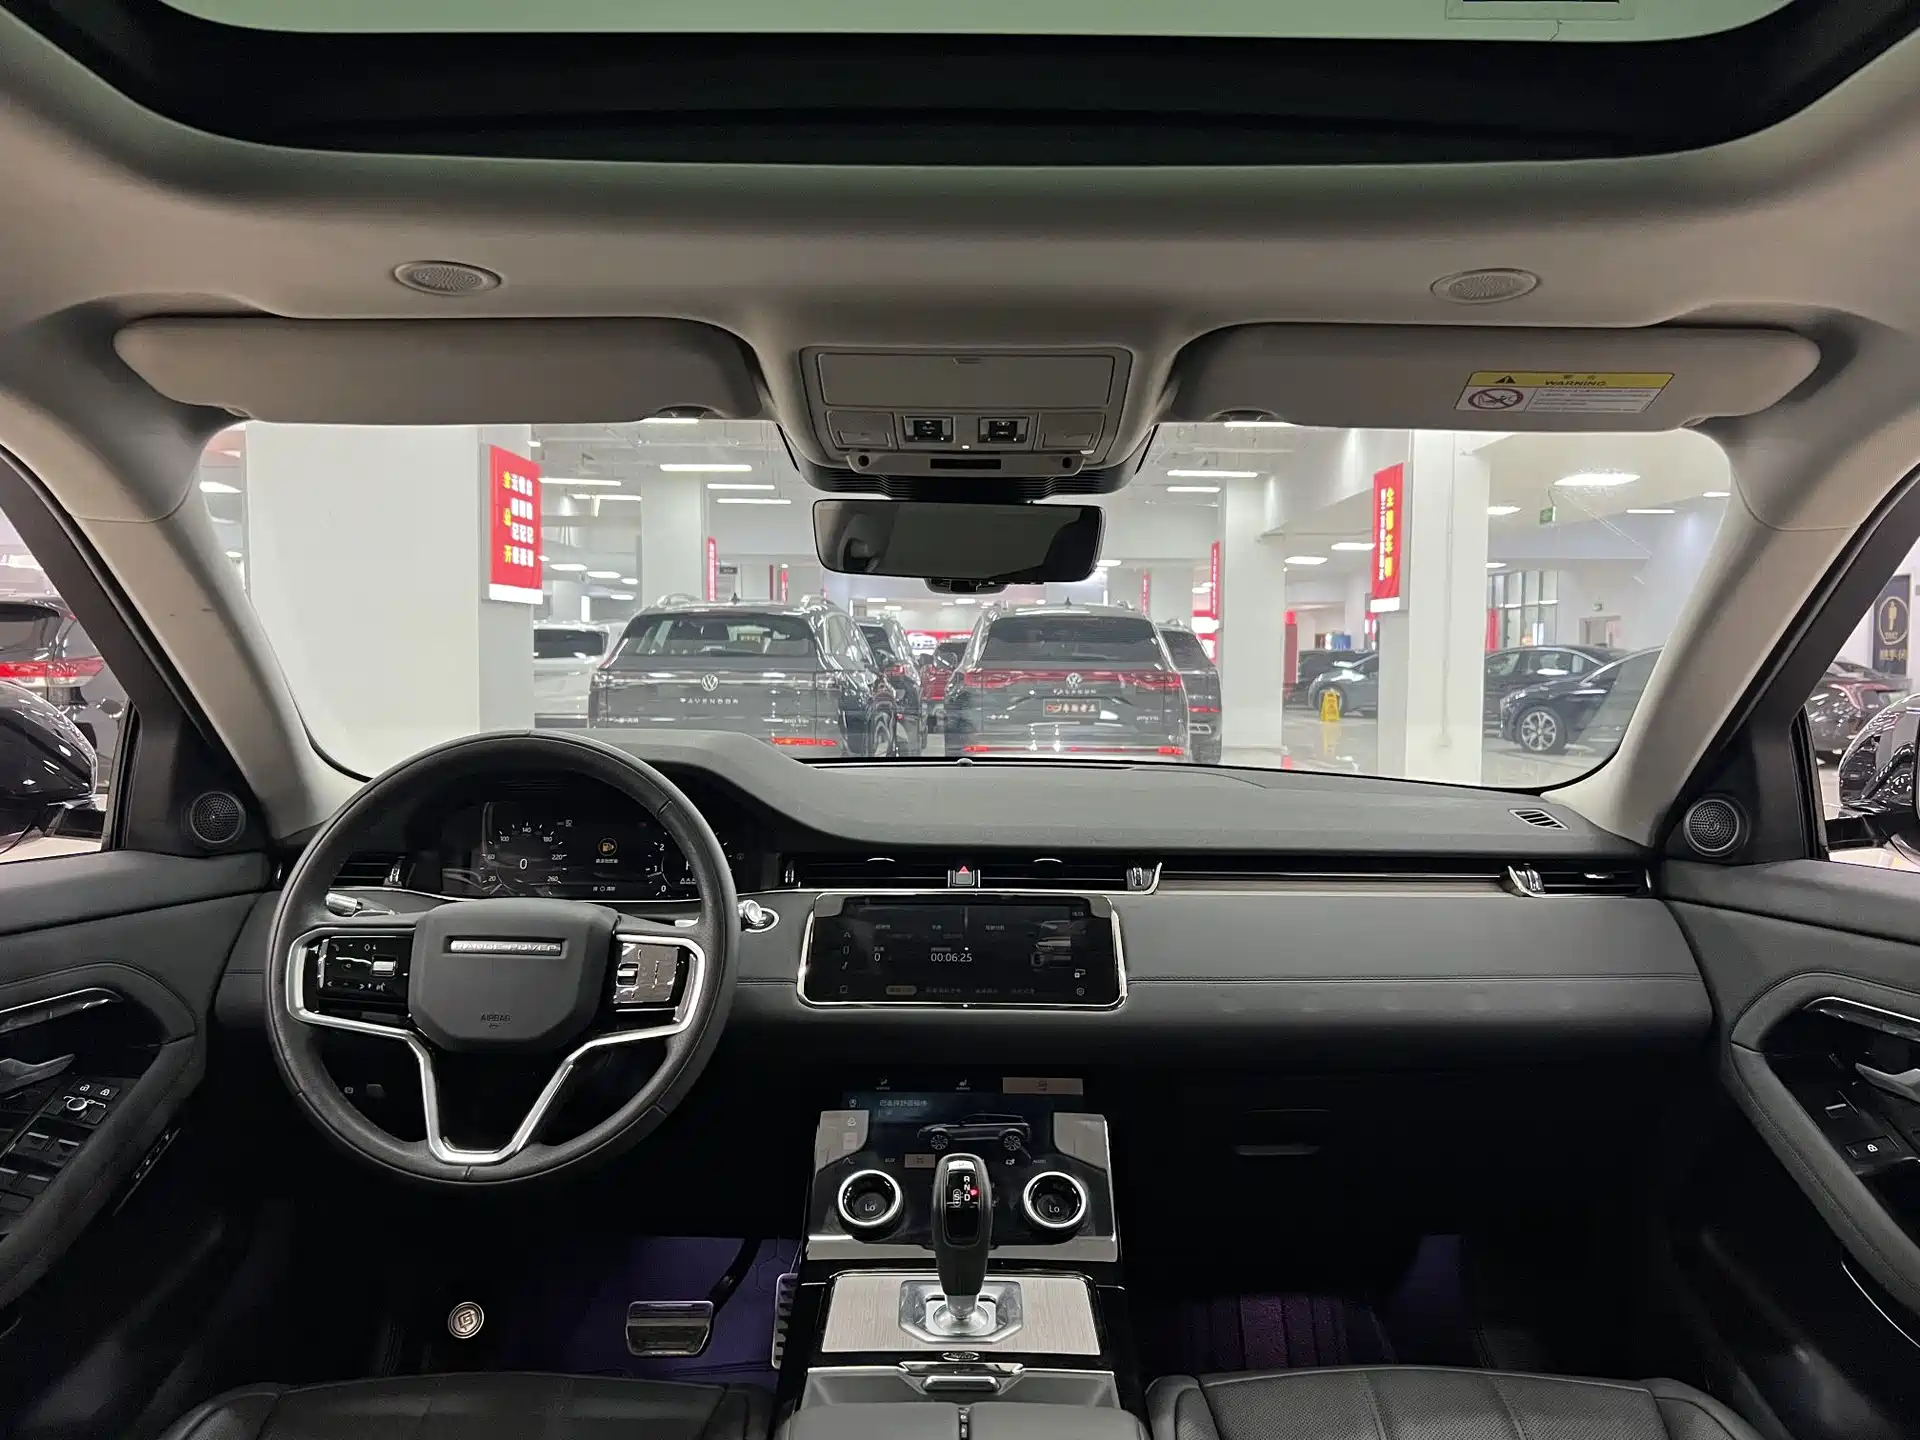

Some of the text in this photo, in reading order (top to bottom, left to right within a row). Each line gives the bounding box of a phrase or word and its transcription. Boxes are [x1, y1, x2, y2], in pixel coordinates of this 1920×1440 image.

[519, 858, 528, 869] 0
[930, 953, 972, 962] 00:06:25
[963, 1193, 970, 1201] D
